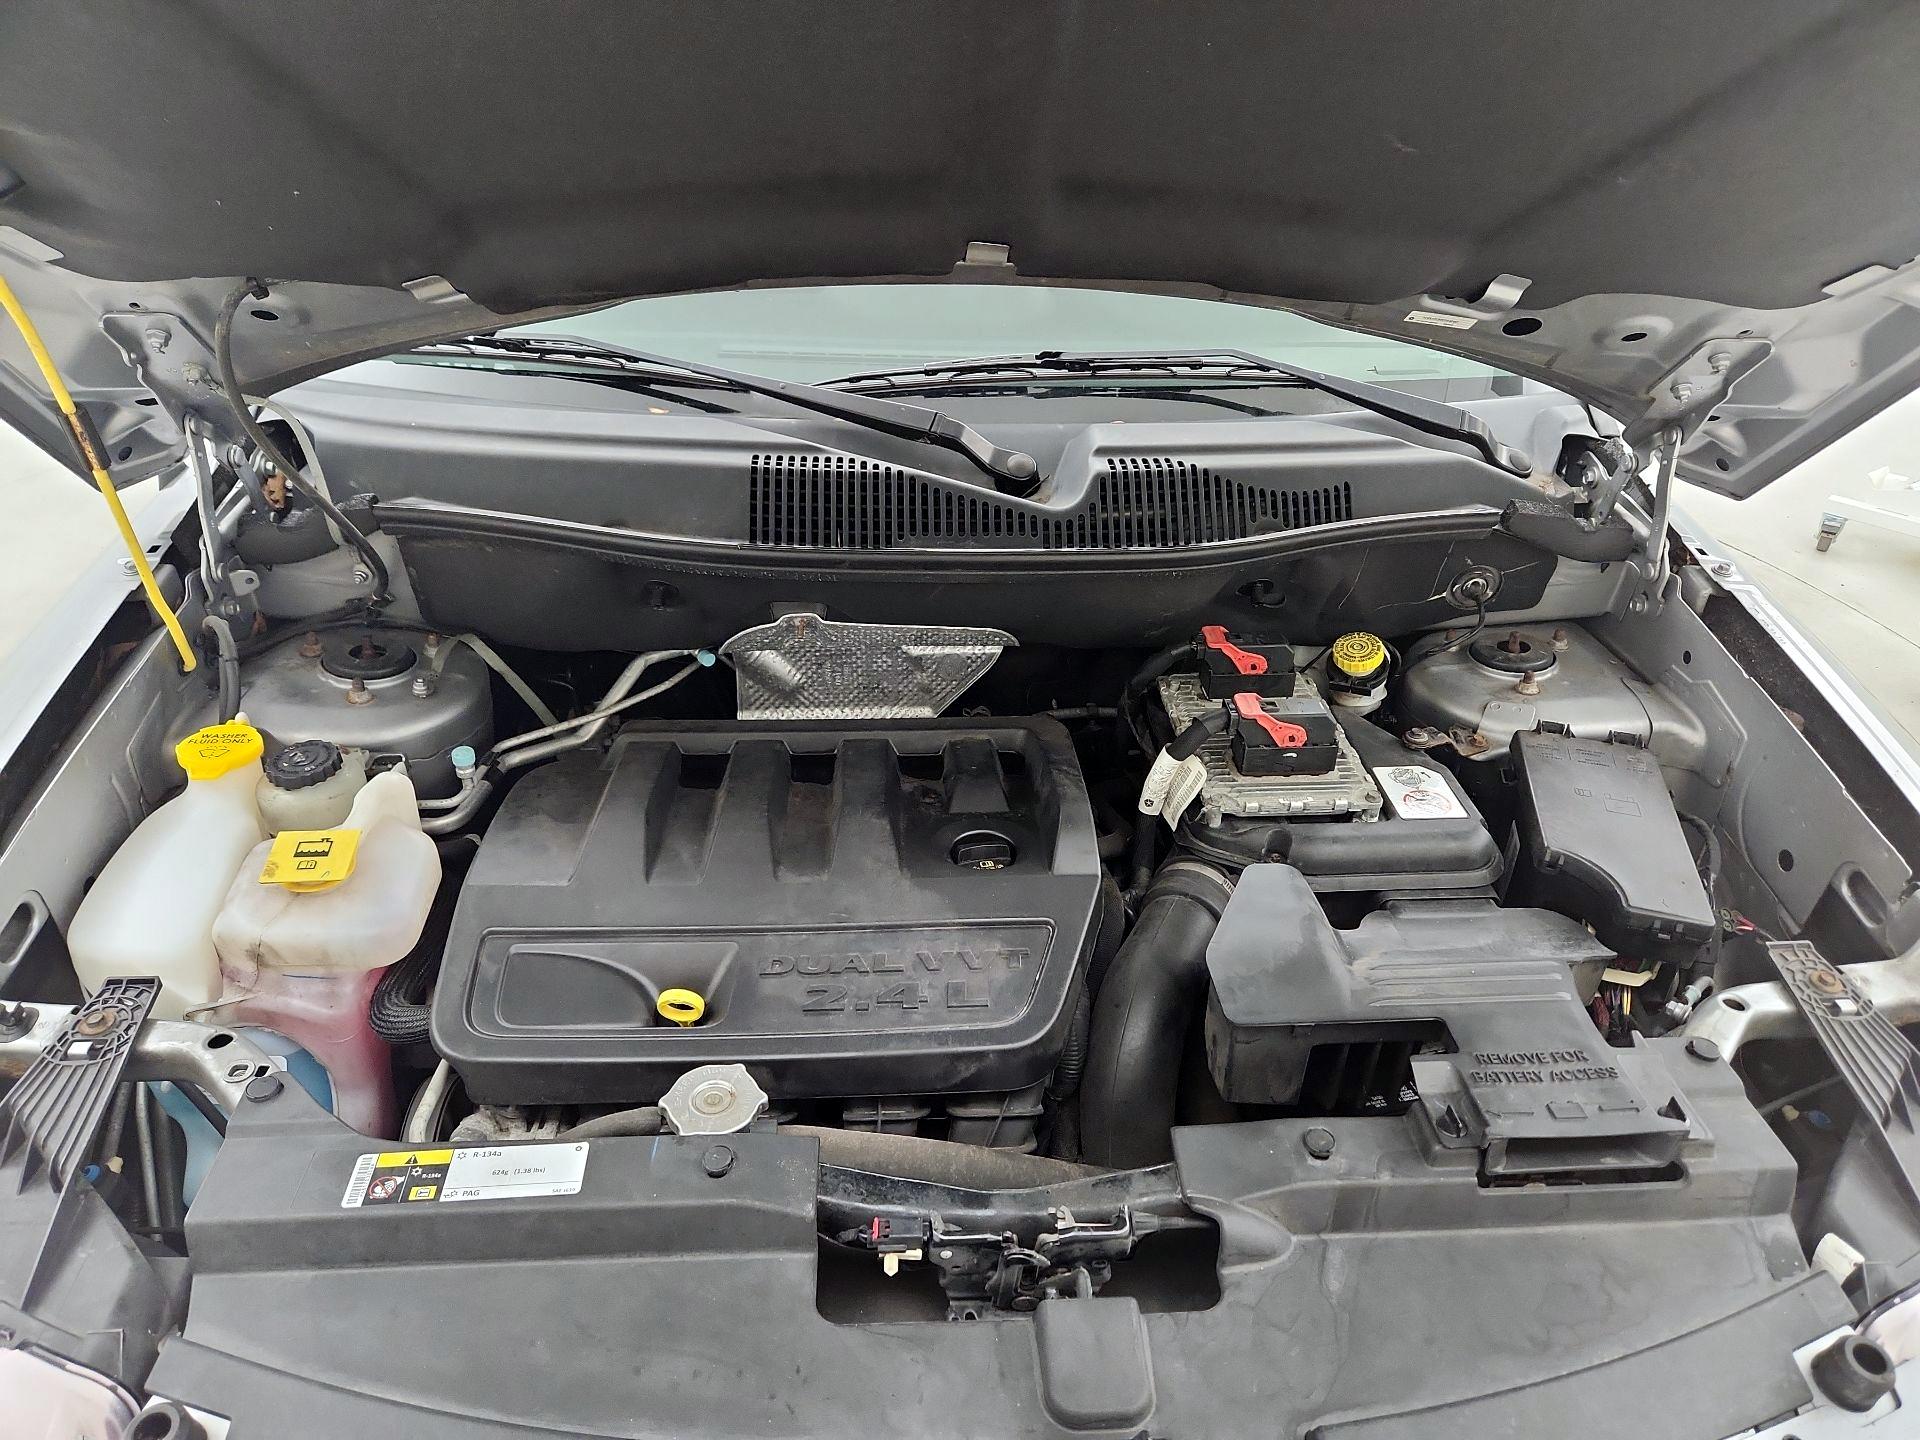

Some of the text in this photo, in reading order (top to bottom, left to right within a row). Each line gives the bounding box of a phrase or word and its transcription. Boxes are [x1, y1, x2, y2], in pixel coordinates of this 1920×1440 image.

[759, 947, 1031, 976] DUAL VVT
[802, 980, 989, 1013] 2.4 L
[1474, 1049, 1589, 1066] REMOVE FOR
[1471, 1066, 1619, 1084] BATTERY ACCESS
[472, 1150, 502, 1158] R-134a
[462, 1189, 480, 1197] PAG
